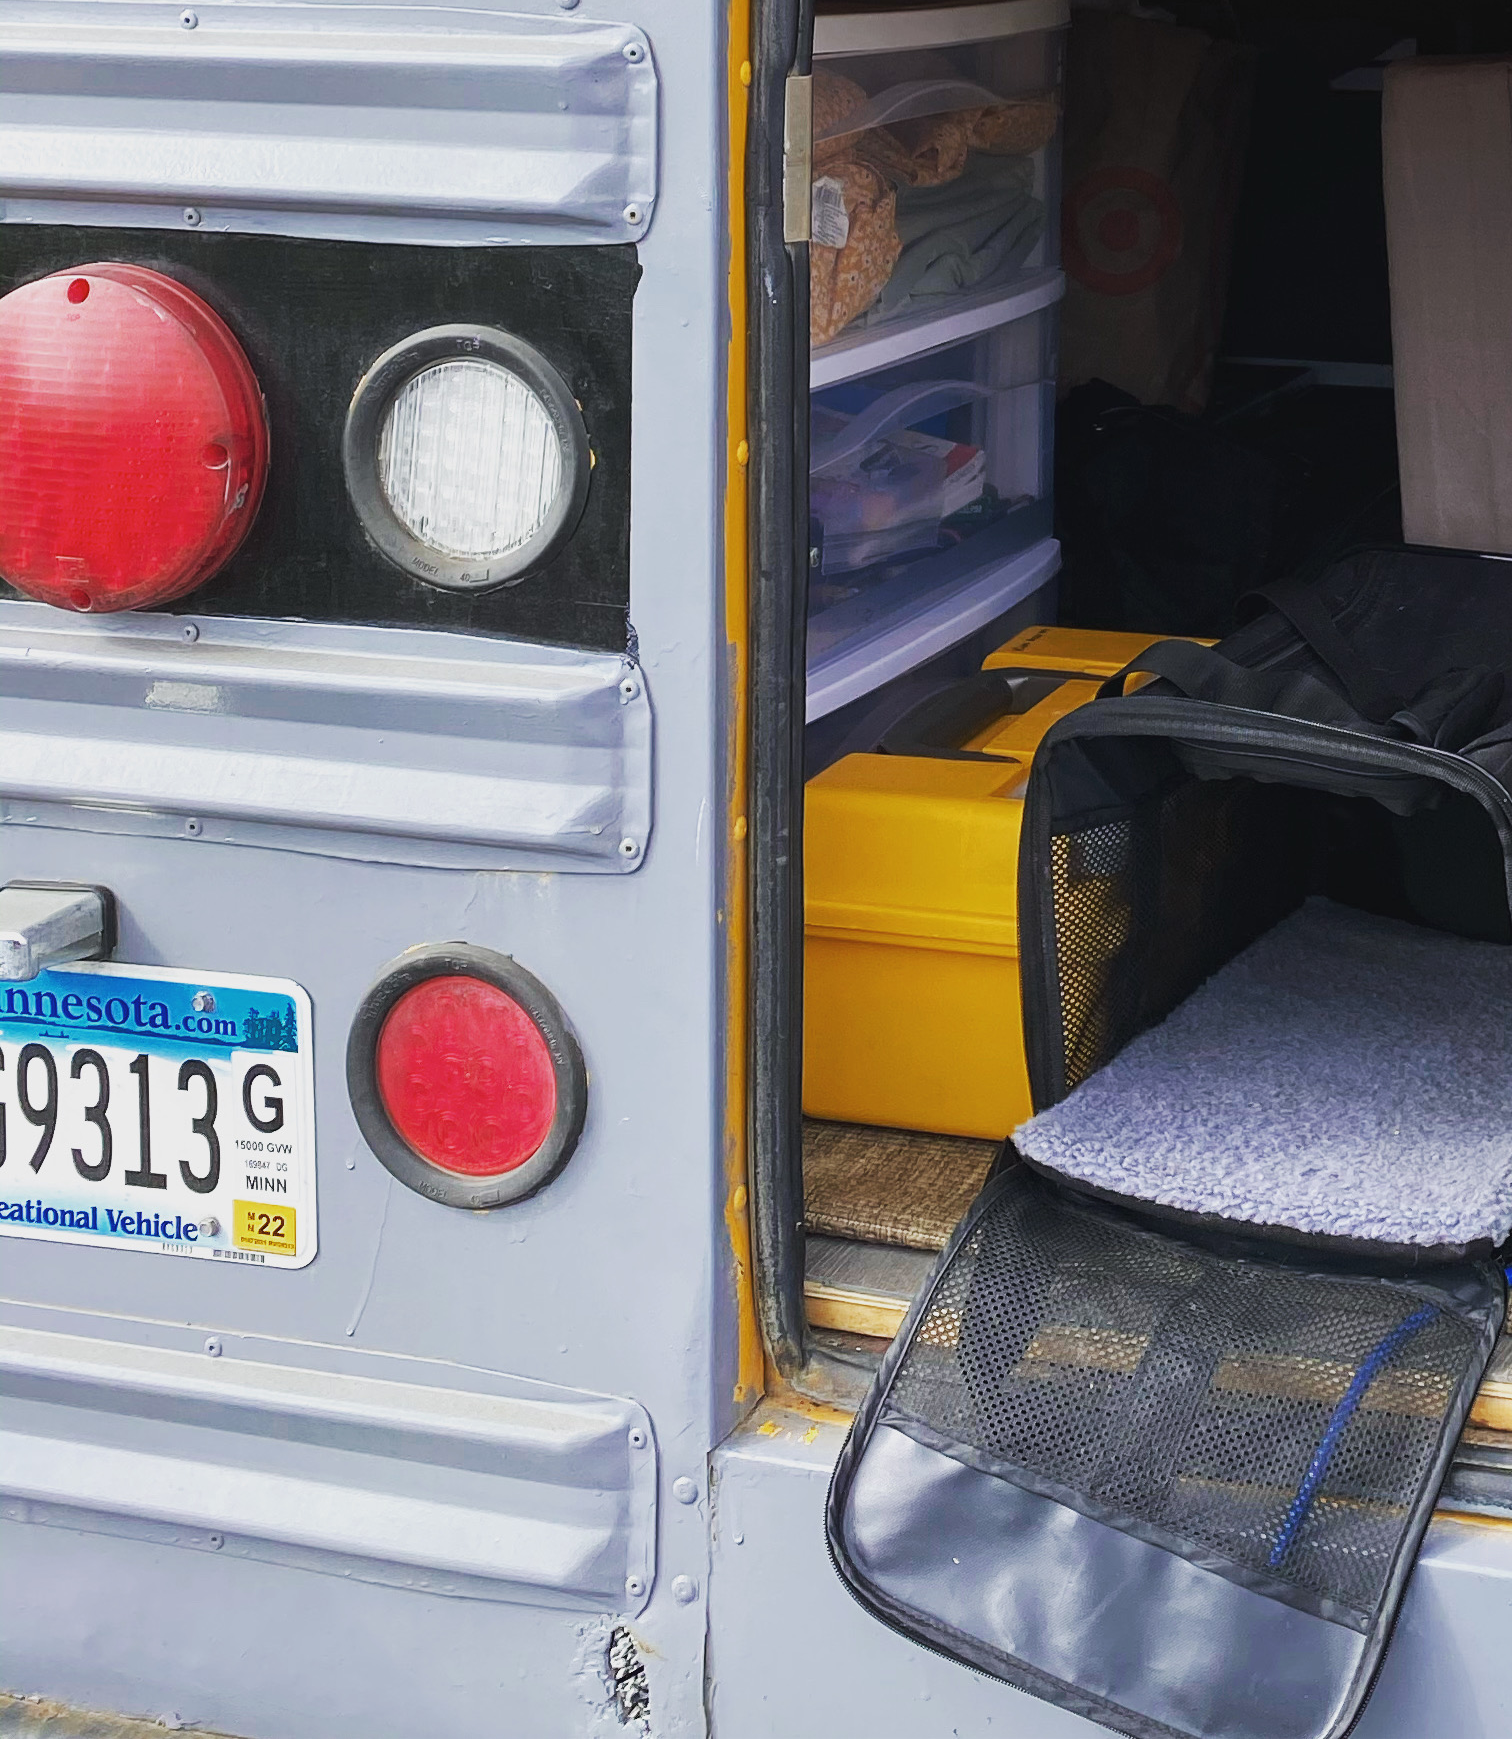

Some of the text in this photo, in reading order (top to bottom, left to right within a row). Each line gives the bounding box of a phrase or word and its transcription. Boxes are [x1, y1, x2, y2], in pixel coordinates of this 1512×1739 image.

[411, 557, 440, 577] MODEL
[0, 986, 237, 1037] nnesota.com
[241, 1063, 286, 1134] G
[0, 1042, 222, 1195] 9313
[234, 1140, 293, 1154] 15000 GVW
[246, 1175, 287, 1194] MINN
[105, 1208, 199, 1242] Vehicle
[258, 1213, 285, 1238] 22
